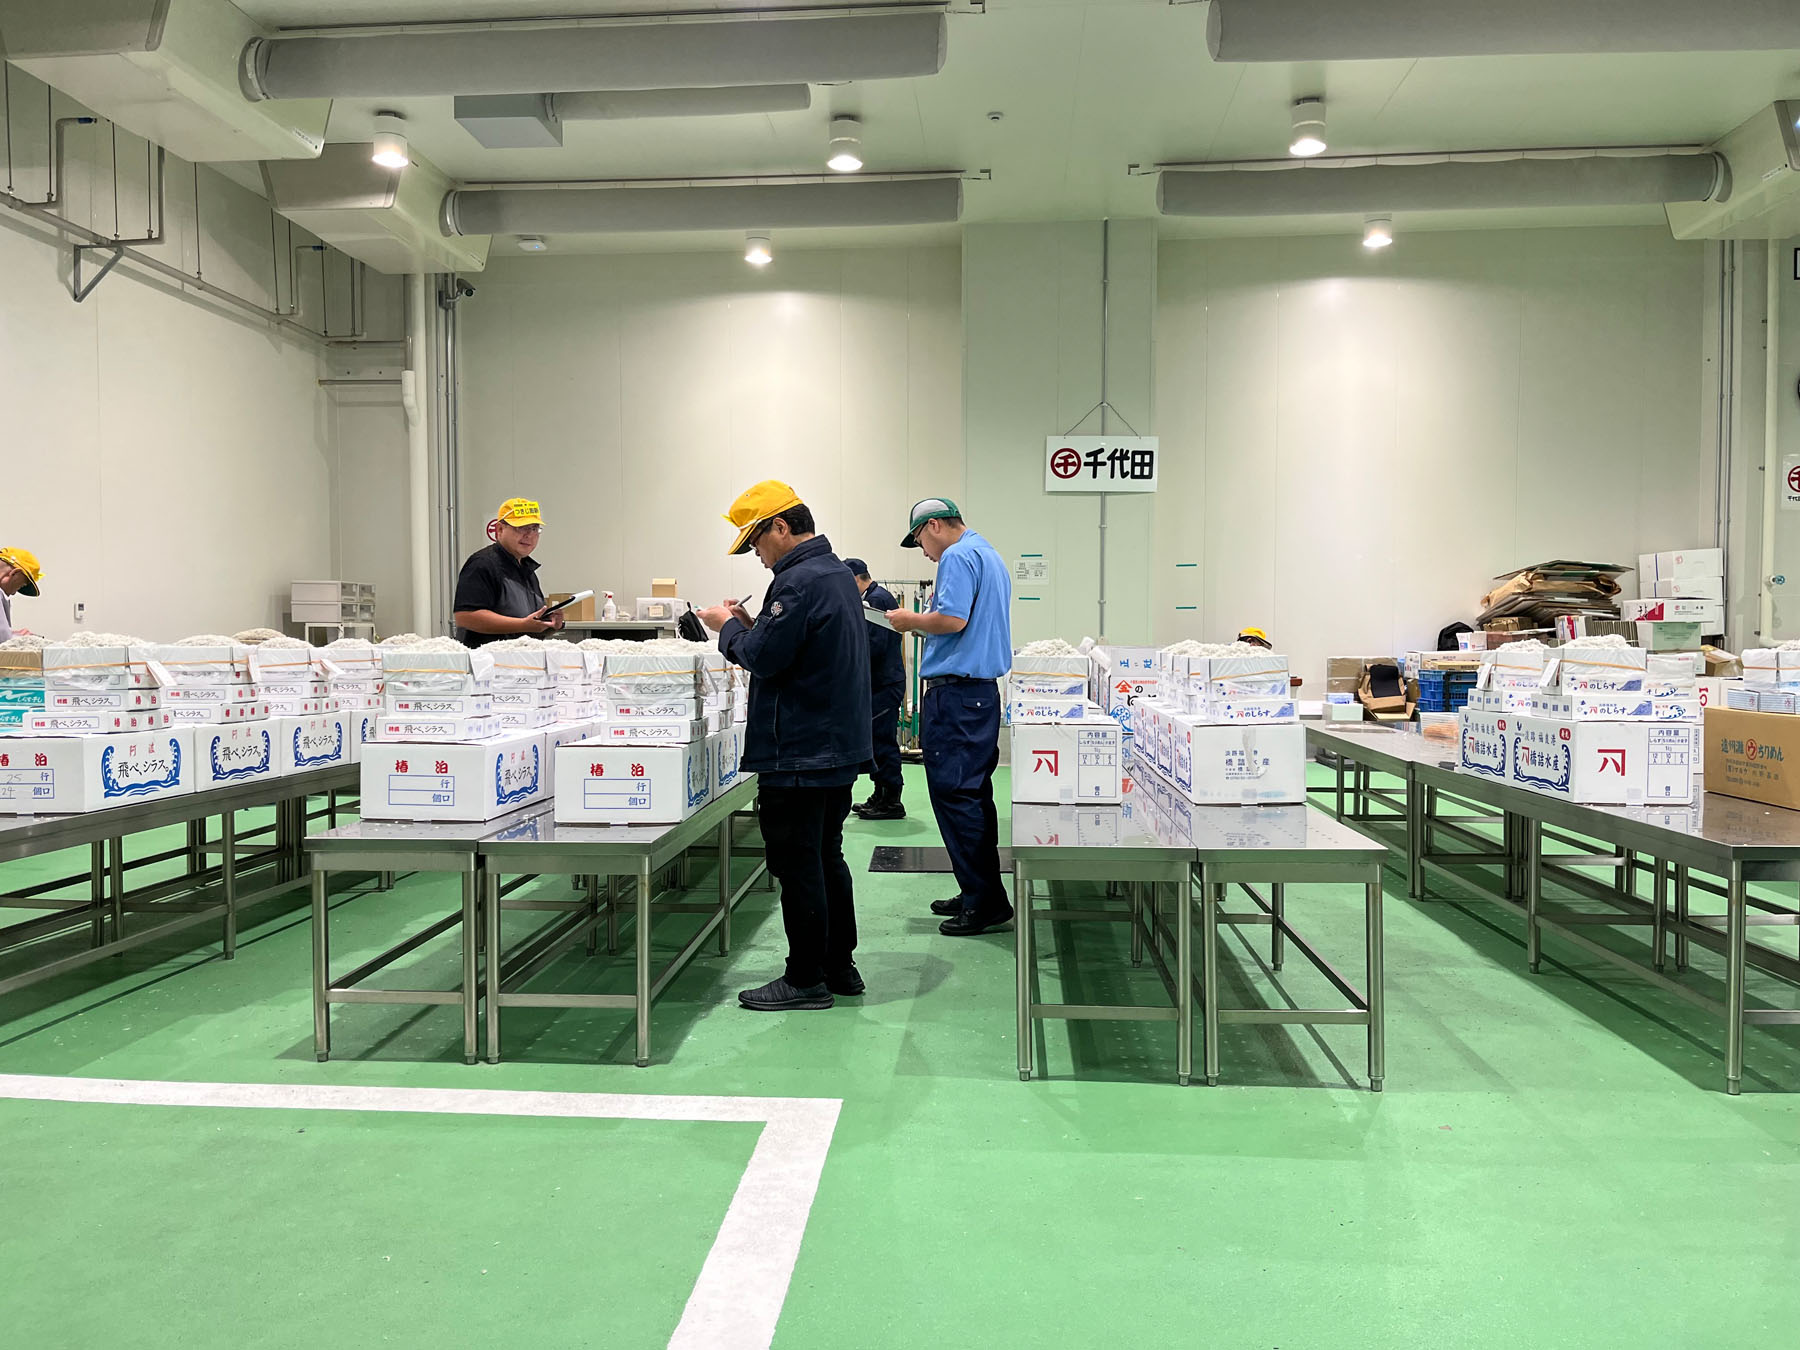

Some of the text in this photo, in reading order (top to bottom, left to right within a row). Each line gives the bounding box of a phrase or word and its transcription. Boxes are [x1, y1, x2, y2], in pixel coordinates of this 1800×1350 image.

[1083, 448, 1154, 479] 千代田
[413, 702, 455, 711] 飛べ、シラス。
[404, 725, 448, 734] 飛べ、シラス。
[222, 745, 261, 761] 飛べ、シラス。
[1758, 743, 1784, 762] ちりめん
[118, 759, 169, 779] 飛べ、シラス。
[394, 759, 449, 774] 椿泊
[590, 763, 645, 777] 椿泊
[40, 772, 50, 782] 行
[440, 778, 451, 789] 行
[636, 782, 647, 792] 行
[33, 786, 50, 796] 個口
[432, 793, 451, 804] 個口
[628, 797, 647, 806] 個口
